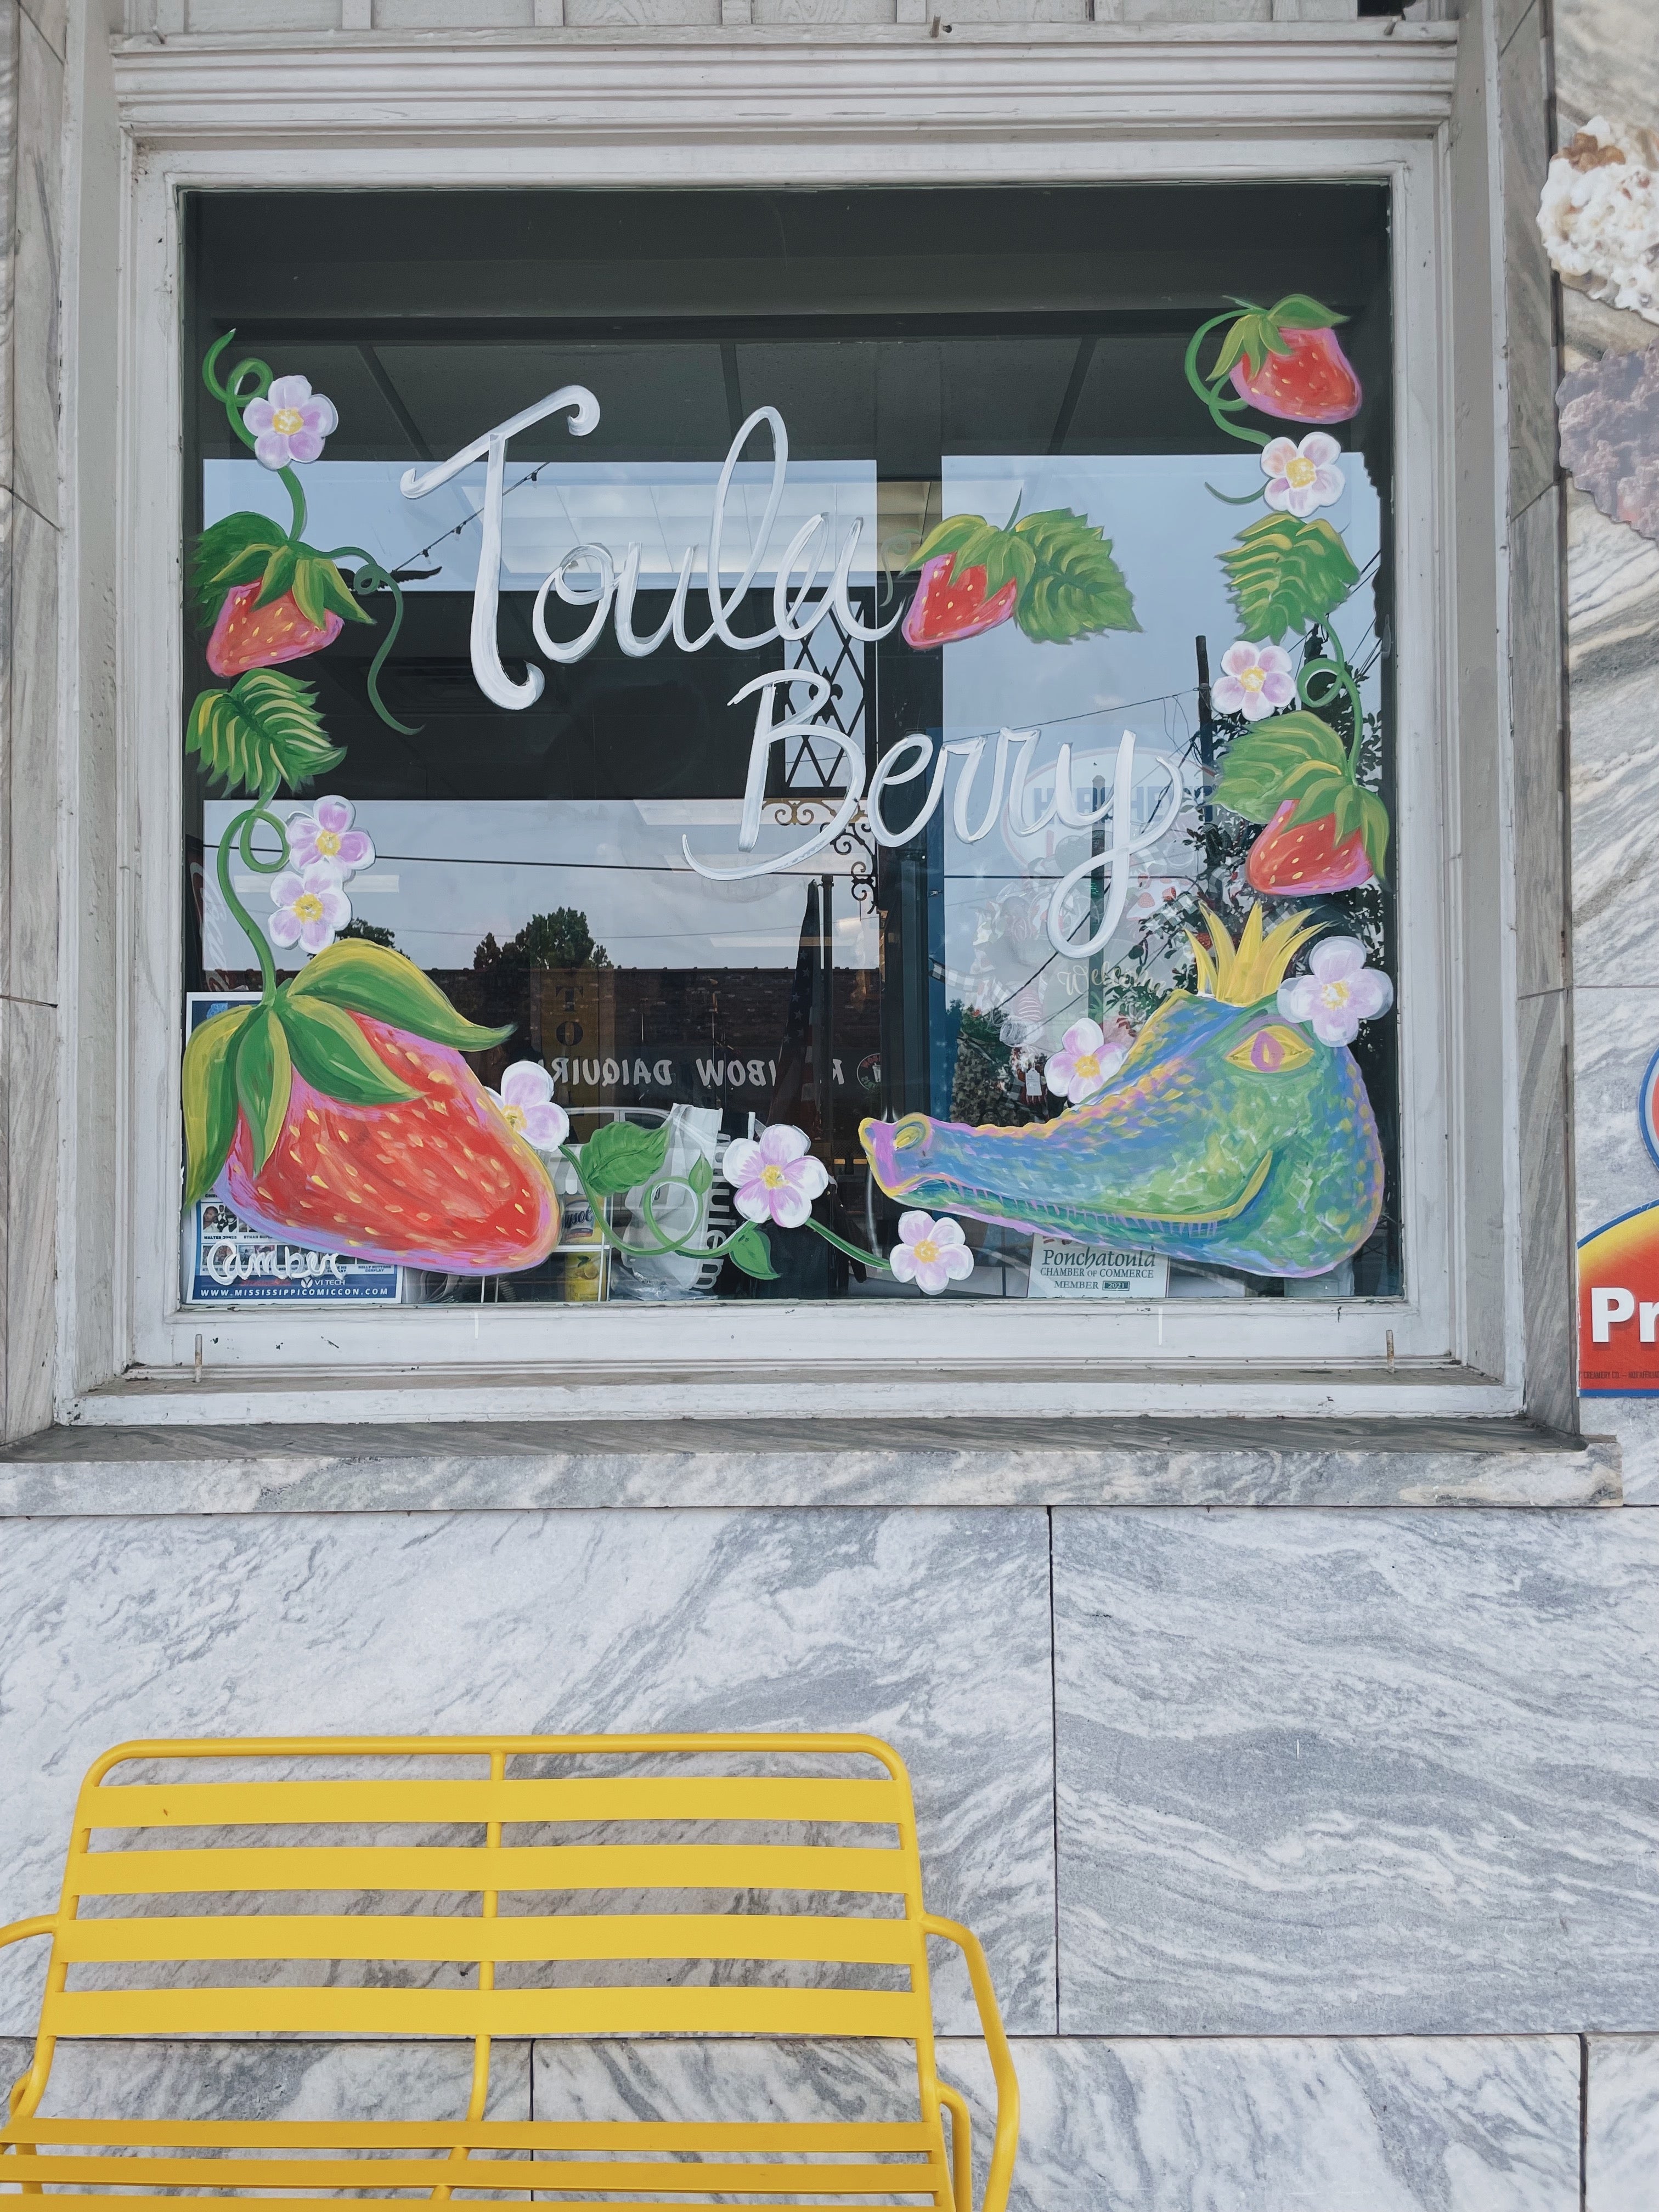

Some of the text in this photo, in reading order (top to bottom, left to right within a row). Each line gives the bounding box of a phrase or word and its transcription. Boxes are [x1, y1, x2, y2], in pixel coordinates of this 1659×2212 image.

[400, 385, 906, 710] Toula
[682, 668, 1183, 960] Berry
[564, 1205, 593, 1229] ysol
[1042, 1246, 1155, 1269] Ponchatoula
[1041, 1267, 1085, 1277] CHAMBER
[1099, 1269, 1154, 1278] COMMERCE
[201, 1288, 387, 1296] WWW.MISSISSIPPICOMICCON.COM
[1054, 1280, 1099, 1289] MEMBER
[1592, 1288, 1659, 1342] Pr
